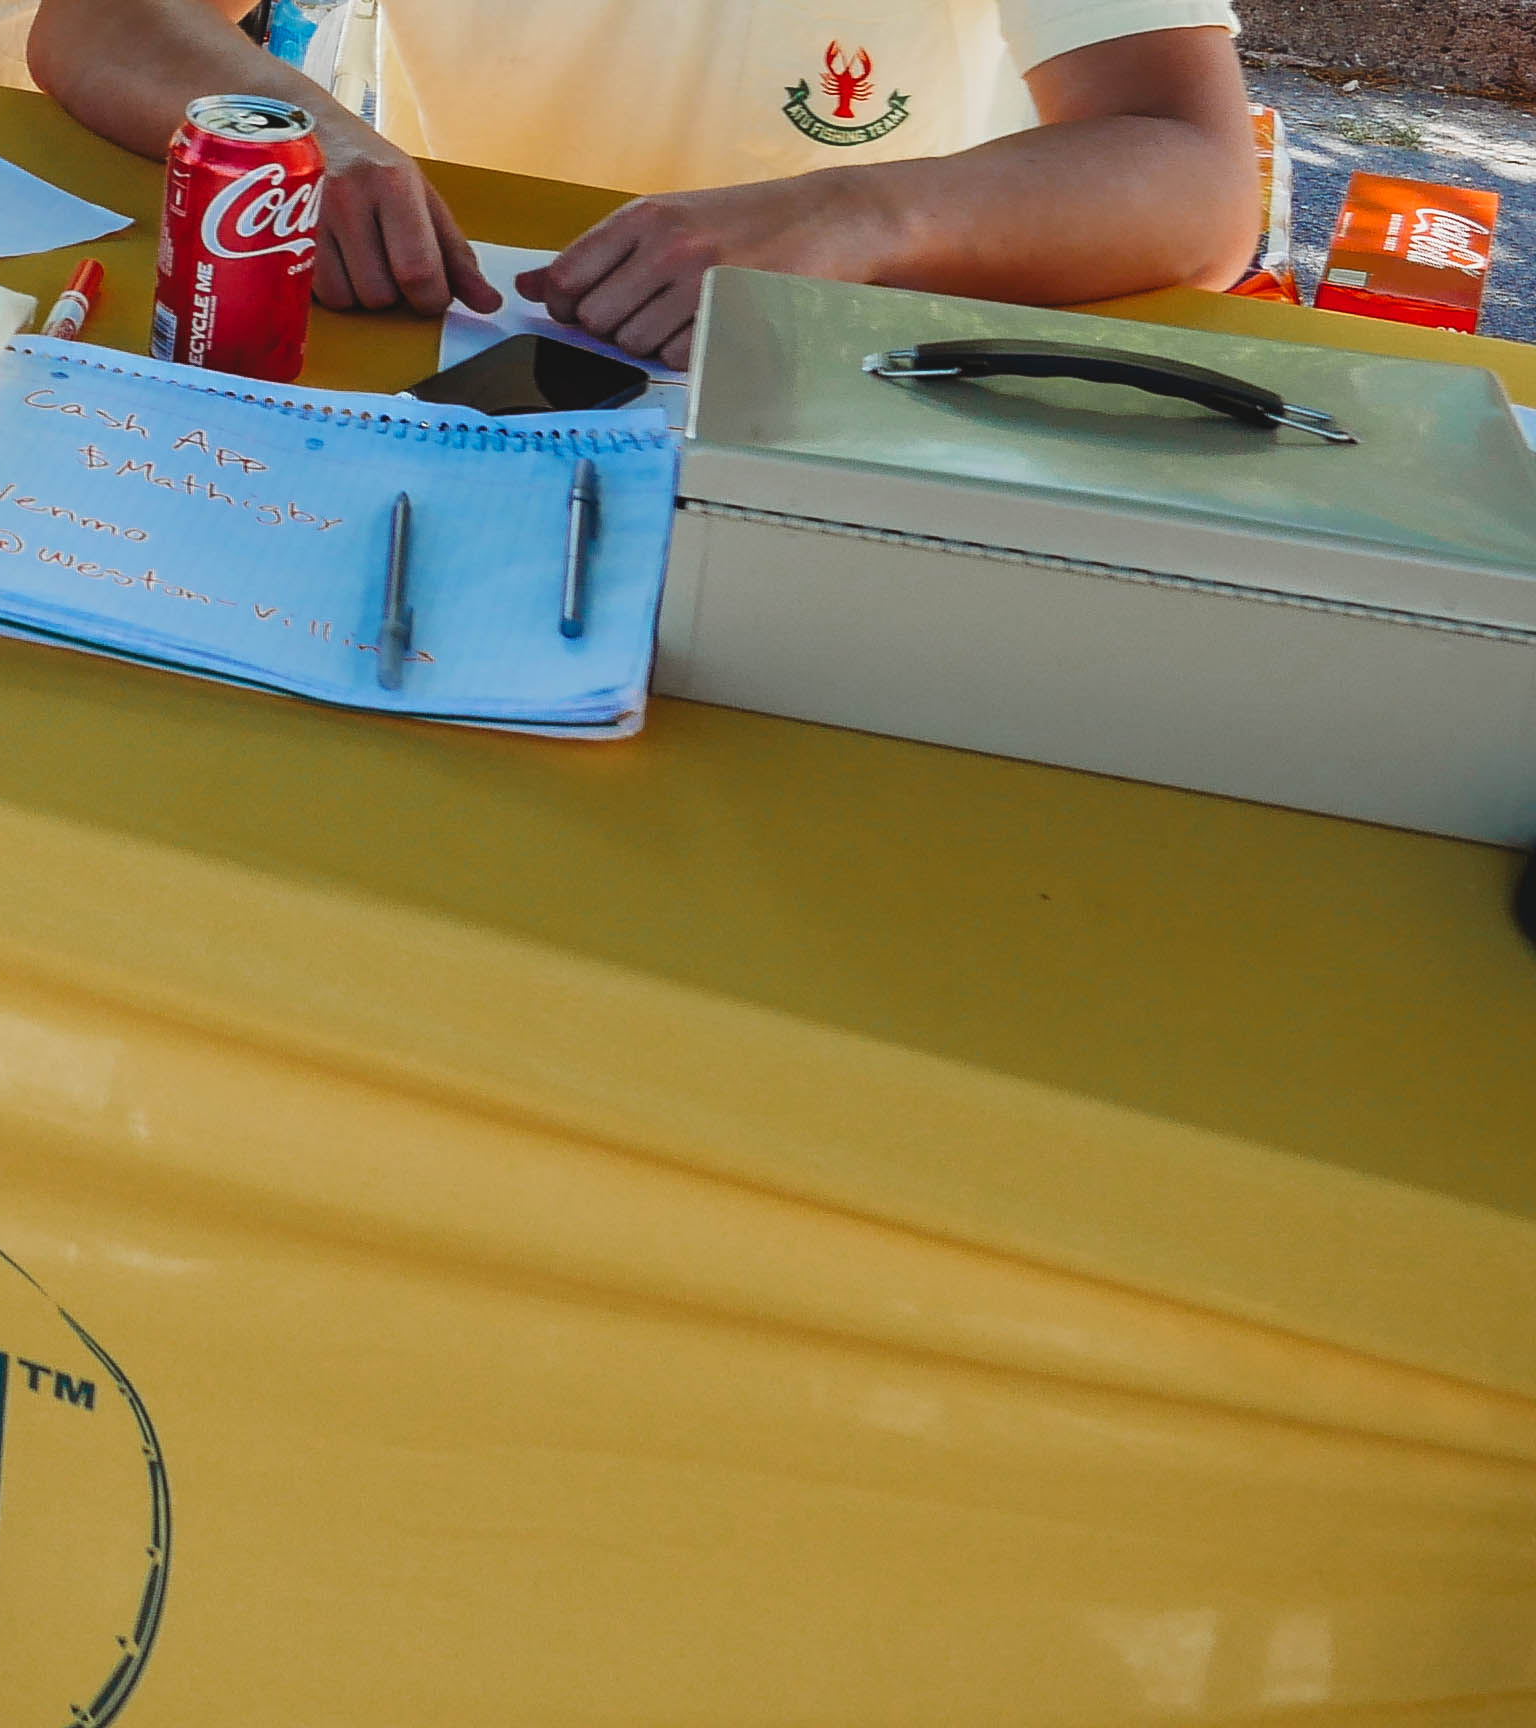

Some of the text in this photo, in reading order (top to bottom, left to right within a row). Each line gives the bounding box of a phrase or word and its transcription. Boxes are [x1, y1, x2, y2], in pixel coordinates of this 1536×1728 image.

[868, 108, 908, 138] TEAM
[195, 261, 214, 294] ME
[189, 294, 210, 368] ECYCLE
[24, 389, 150, 440] Cash
